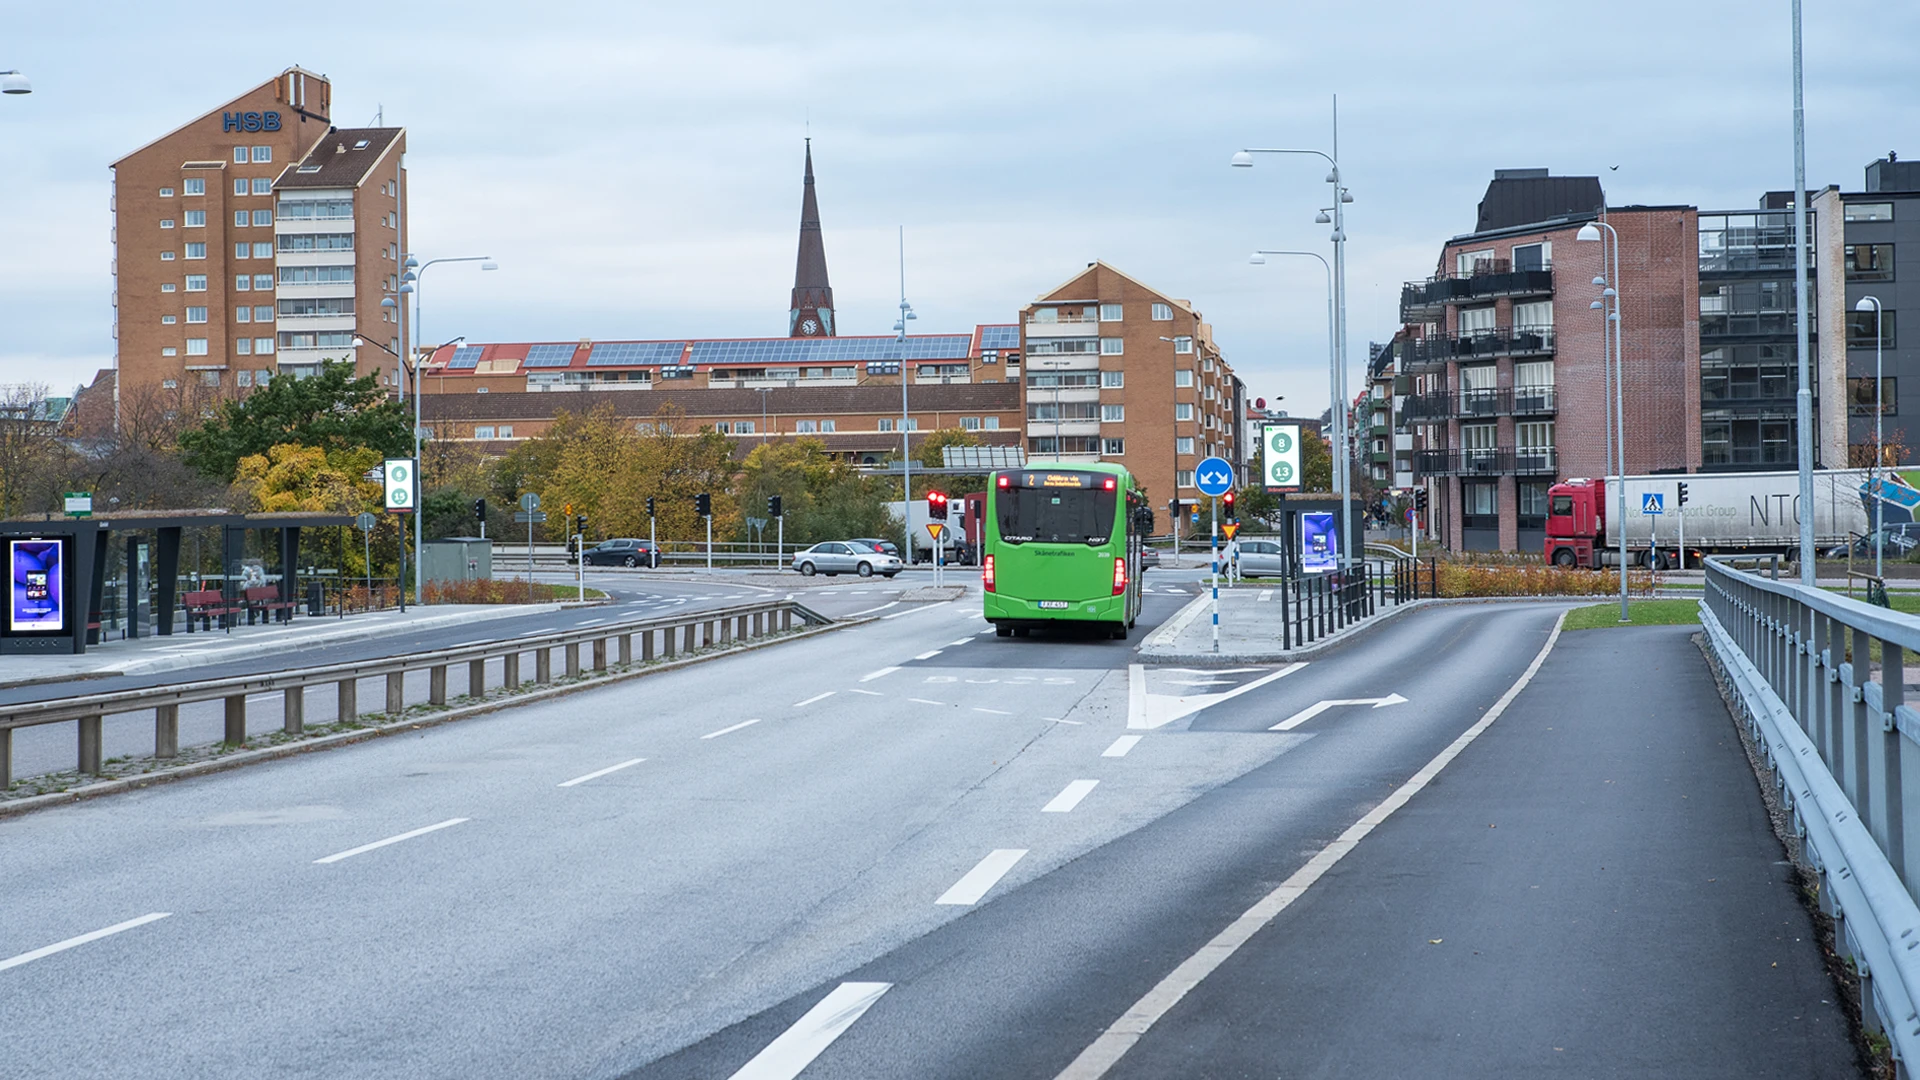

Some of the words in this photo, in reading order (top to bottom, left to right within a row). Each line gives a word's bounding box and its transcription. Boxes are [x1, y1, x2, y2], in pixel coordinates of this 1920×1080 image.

[223, 111, 281, 132] HSB
[1278, 438, 1286, 448] 8
[396, 470, 402, 479] 6
[1276, 467, 1289, 477] 13
[1028, 474, 1034, 486] 2
[394, 492, 406, 500] 15
[1706, 504, 1737, 519] Group
[921, 675, 1077, 686] BUSS
